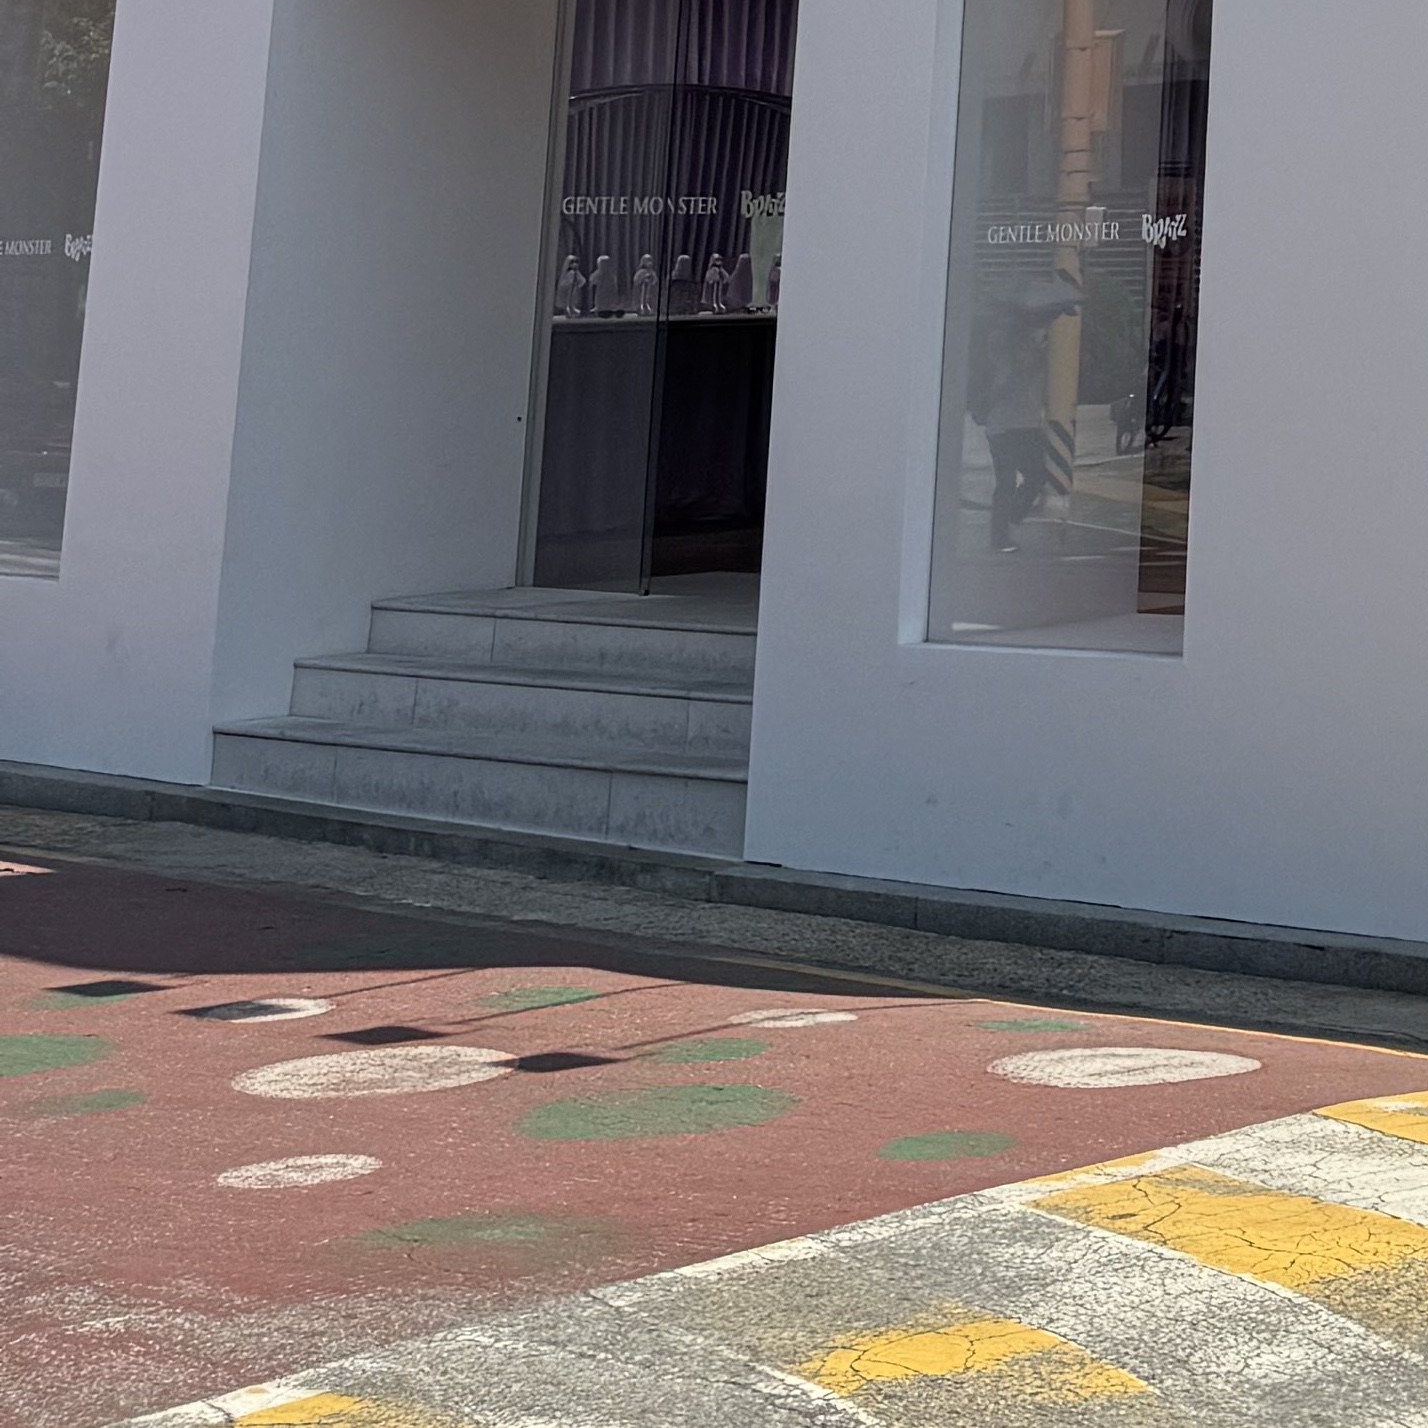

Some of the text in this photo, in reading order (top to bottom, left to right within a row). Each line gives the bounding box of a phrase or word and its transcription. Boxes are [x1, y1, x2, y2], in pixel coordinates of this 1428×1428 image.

[562, 196, 629, 215] GENTLE
[988, 225, 1046, 244] GENTLE
[1047, 221, 1120, 242] MONSTER
